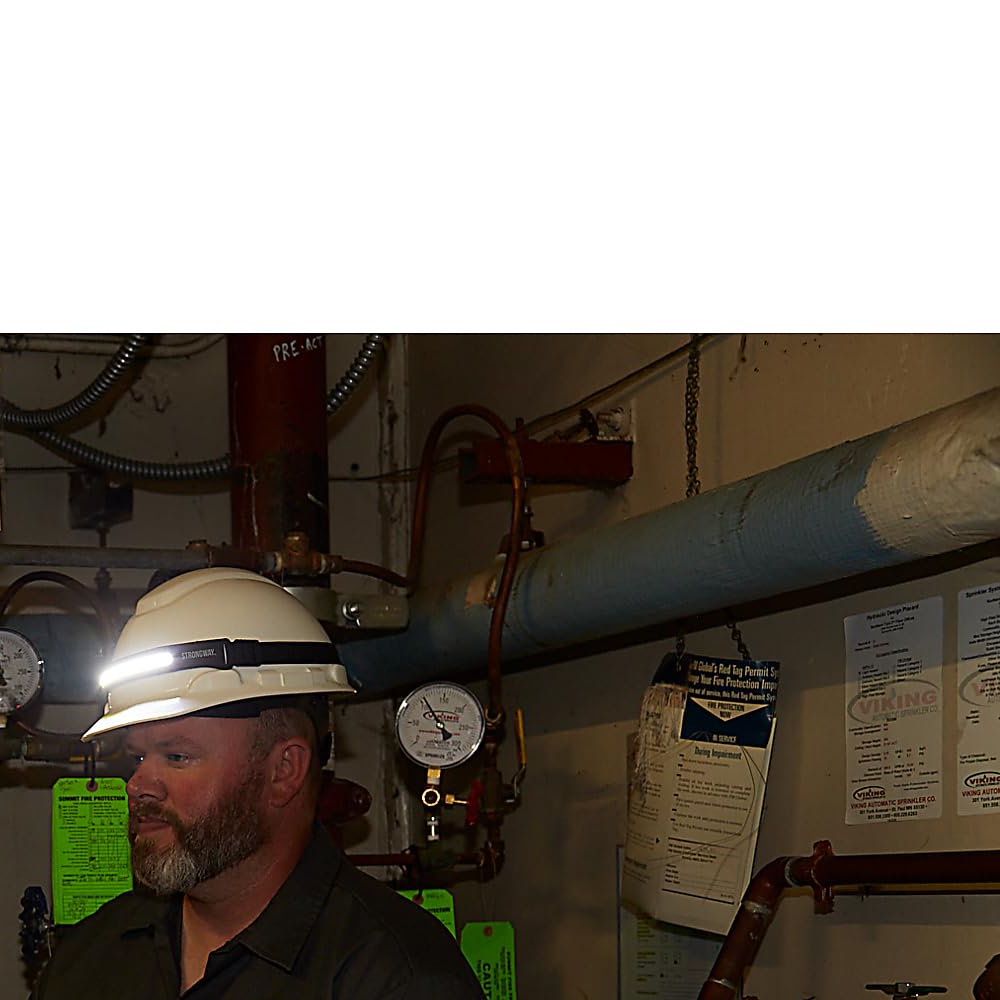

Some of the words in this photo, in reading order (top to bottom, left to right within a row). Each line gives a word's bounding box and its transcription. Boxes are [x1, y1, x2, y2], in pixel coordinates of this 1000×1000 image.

[719, 662, 731, 674] Red
[733, 664, 743, 678] Tag
[744, 666, 769, 677] Permit
[713, 676, 724, 686] Fire
[726, 677, 760, 688] Protection
[749, 692, 765, 700] Permit
[718, 703, 744, 711] PROTECTION
[860, 690, 937, 714] VIKING
[718, 735, 737, 743] SERVICE
[695, 747, 711, 758] During
[712, 749, 741, 760] Impairment
[857, 790, 885, 798] VIKING
[868, 800, 896, 808] AUTOMATIC
[898, 797, 926, 805] SPRINKLER
